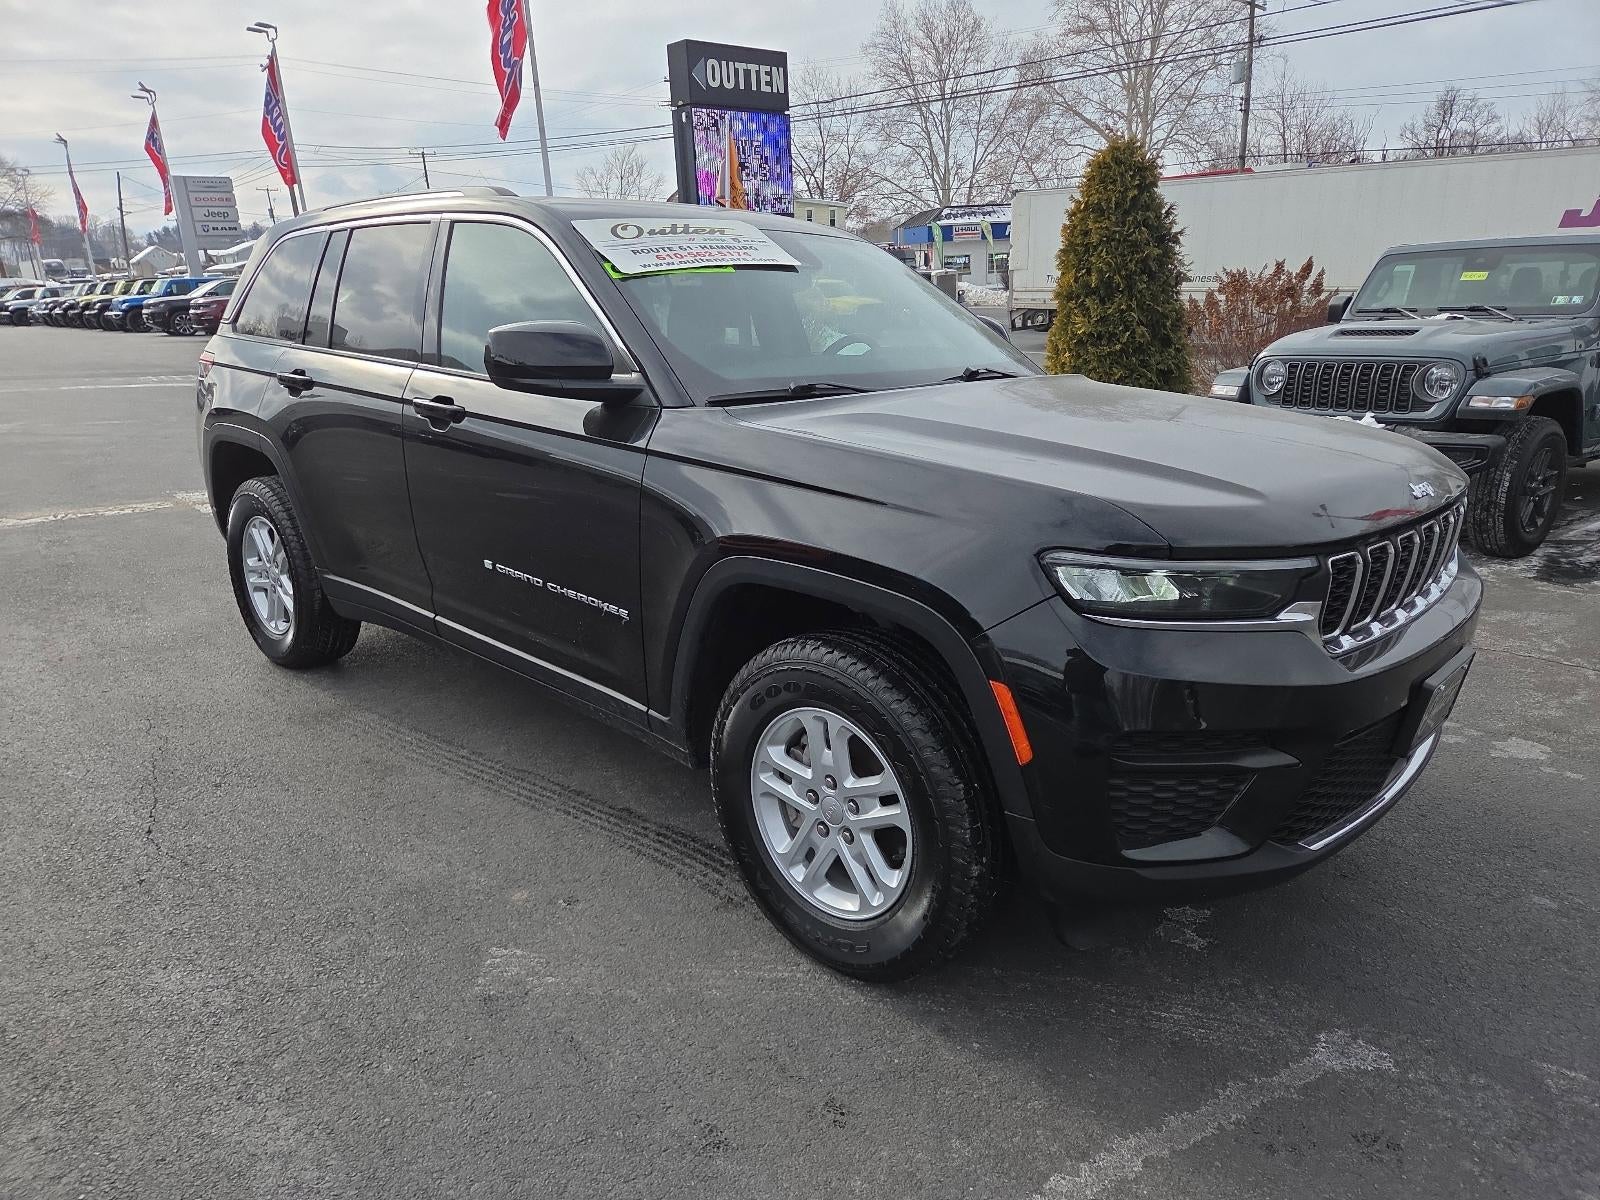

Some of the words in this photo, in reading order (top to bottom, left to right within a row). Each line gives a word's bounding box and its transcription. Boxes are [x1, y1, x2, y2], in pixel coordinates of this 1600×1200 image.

[706, 58, 785, 94] OUTTEN
[203, 209, 229, 219] Jeep
[610, 222, 735, 240] Outten
[630, 246, 676, 256] ROUTE
[495, 563, 543, 588] GRAND
[546, 582, 630, 619] CHEROKEE
